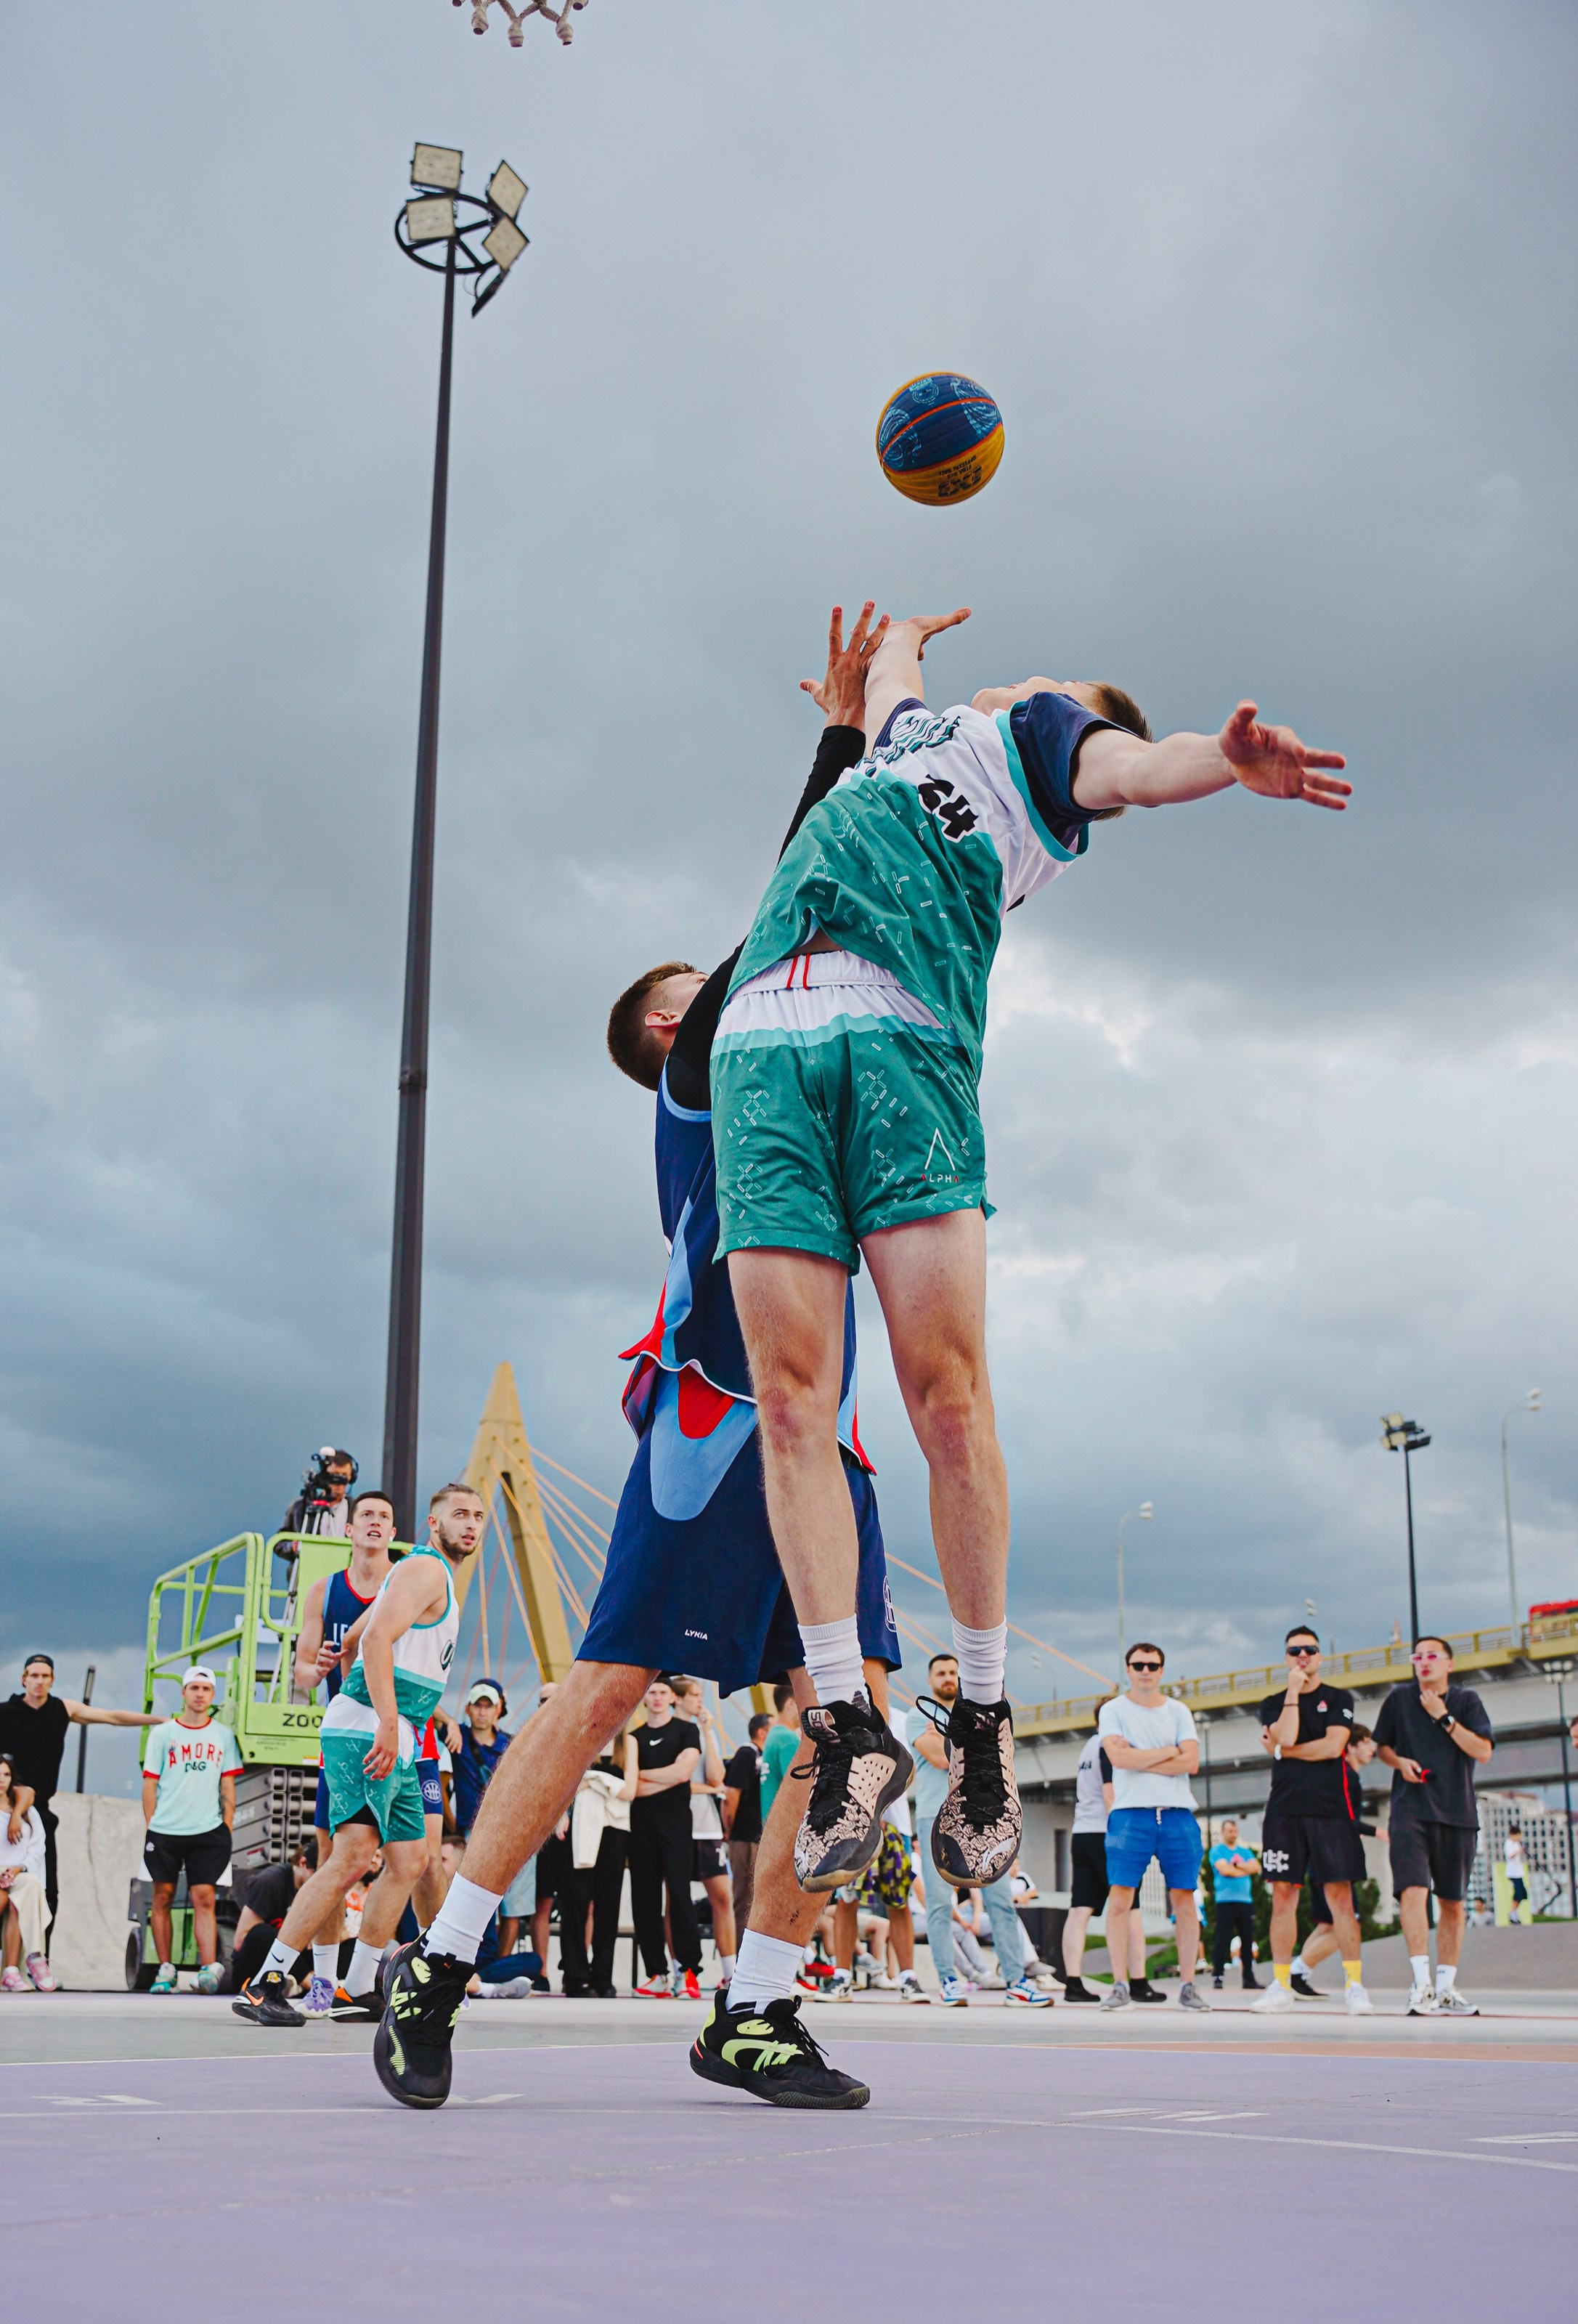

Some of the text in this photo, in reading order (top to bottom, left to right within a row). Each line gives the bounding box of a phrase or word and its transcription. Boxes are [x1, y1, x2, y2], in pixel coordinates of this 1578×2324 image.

[952, 455, 977, 471] OFFICIAL
[959, 464, 972, 474] FIBA
[920, 1173, 959, 1184] ALPHA
[684, 1628, 708, 1641] LYKIA
